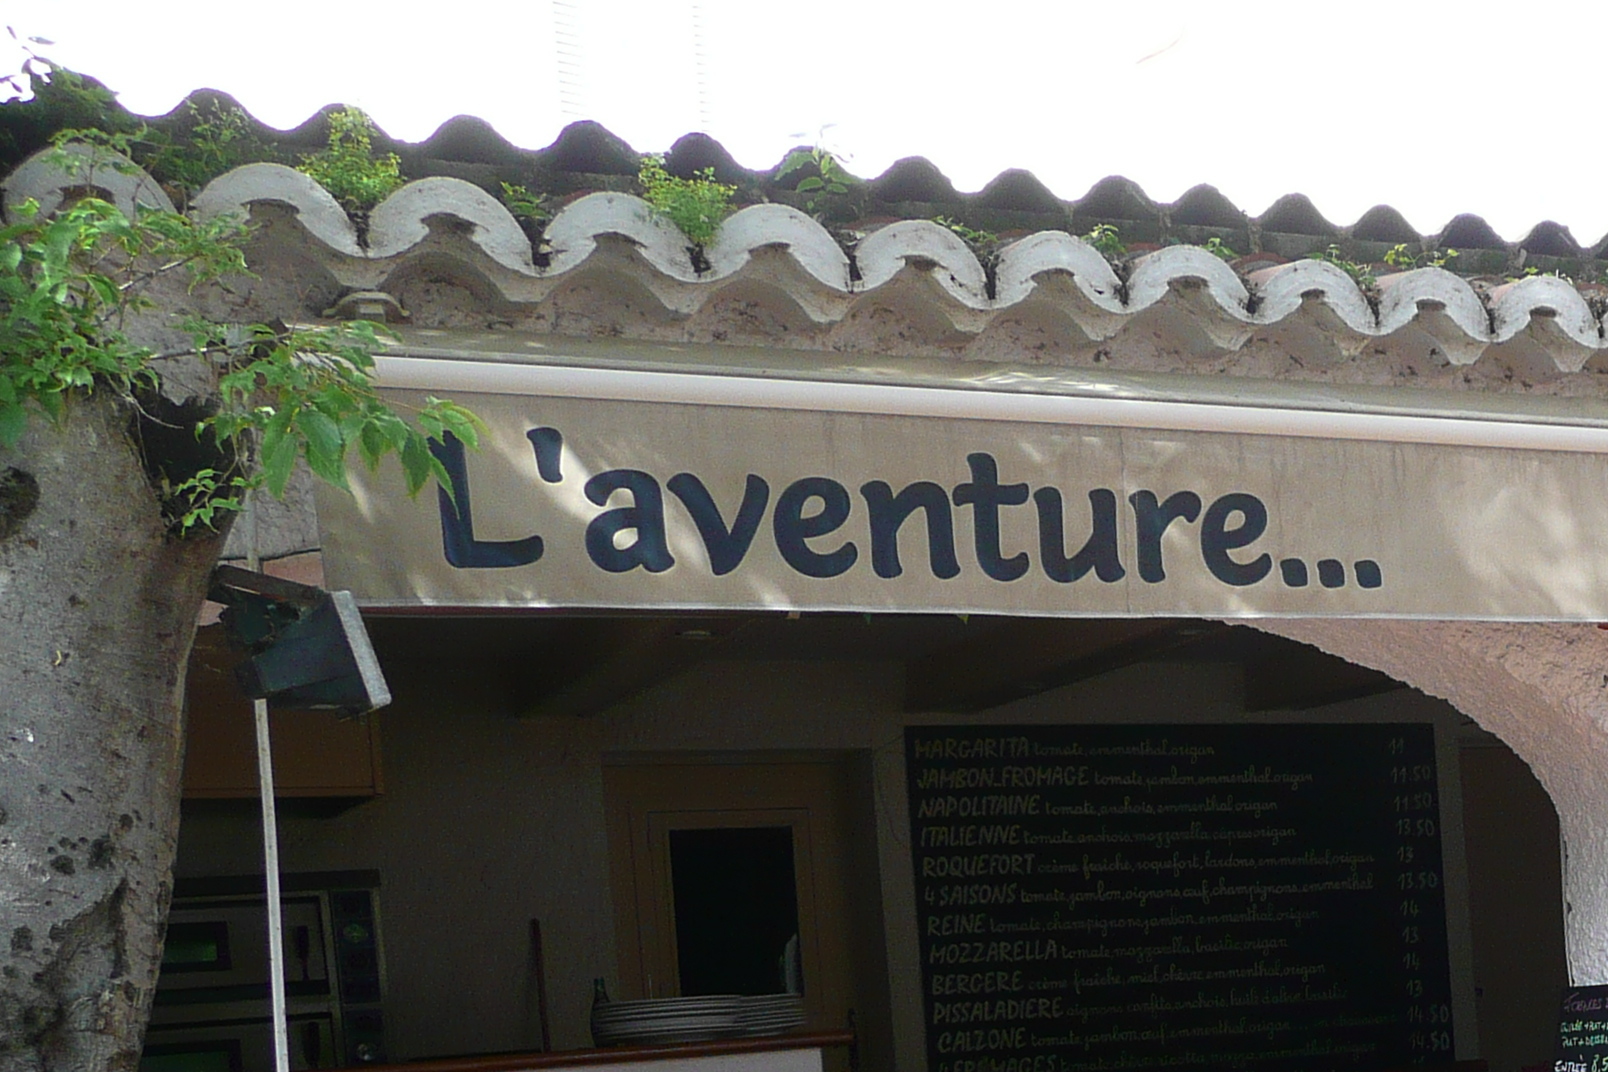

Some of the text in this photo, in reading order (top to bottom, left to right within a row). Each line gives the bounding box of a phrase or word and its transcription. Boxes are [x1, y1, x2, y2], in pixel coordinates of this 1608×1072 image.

[915, 736, 1029, 760] MARGARITA
[918, 795, 1041, 819] NAPOLITAINE
[920, 825, 1021, 847] ITALIENNE
[922, 853, 1035, 878] ROQUEFORT
[939, 883, 1018, 907] SAISONS
[928, 913, 986, 937] REINE
[929, 938, 1058, 964] MOZZARELLA
[932, 969, 1024, 996] BERGERE
[933, 996, 1064, 1024] PISSALADIERE
[937, 1026, 1026, 1053] CALZONE
